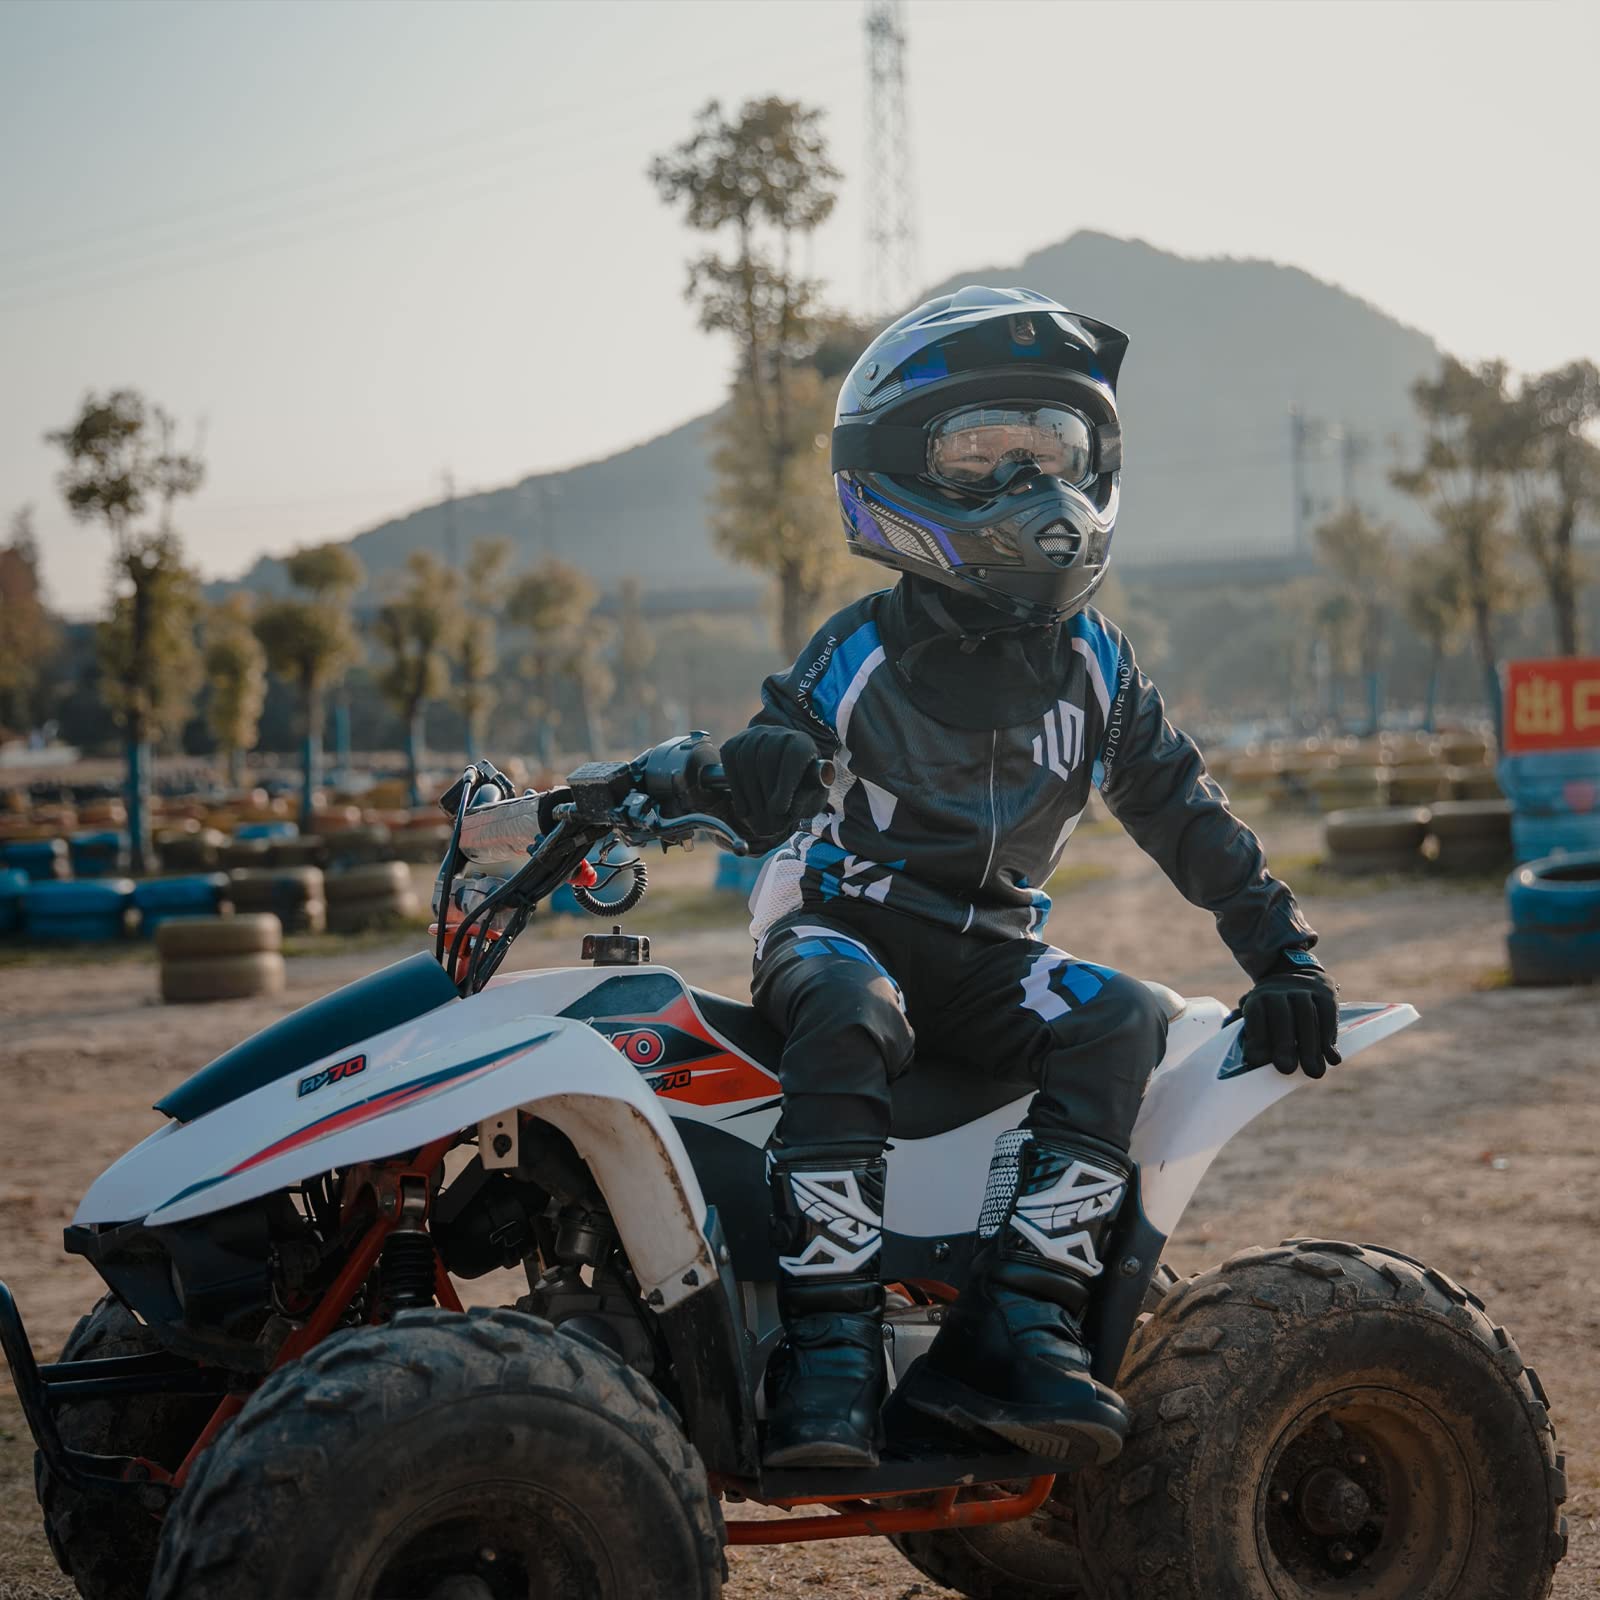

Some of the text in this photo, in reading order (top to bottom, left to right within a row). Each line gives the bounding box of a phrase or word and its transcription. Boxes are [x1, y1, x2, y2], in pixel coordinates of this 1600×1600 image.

[797, 680, 812, 710] LIVE
[1111, 693, 1125, 725] LIVE
[1108, 726, 1121, 745] TO
